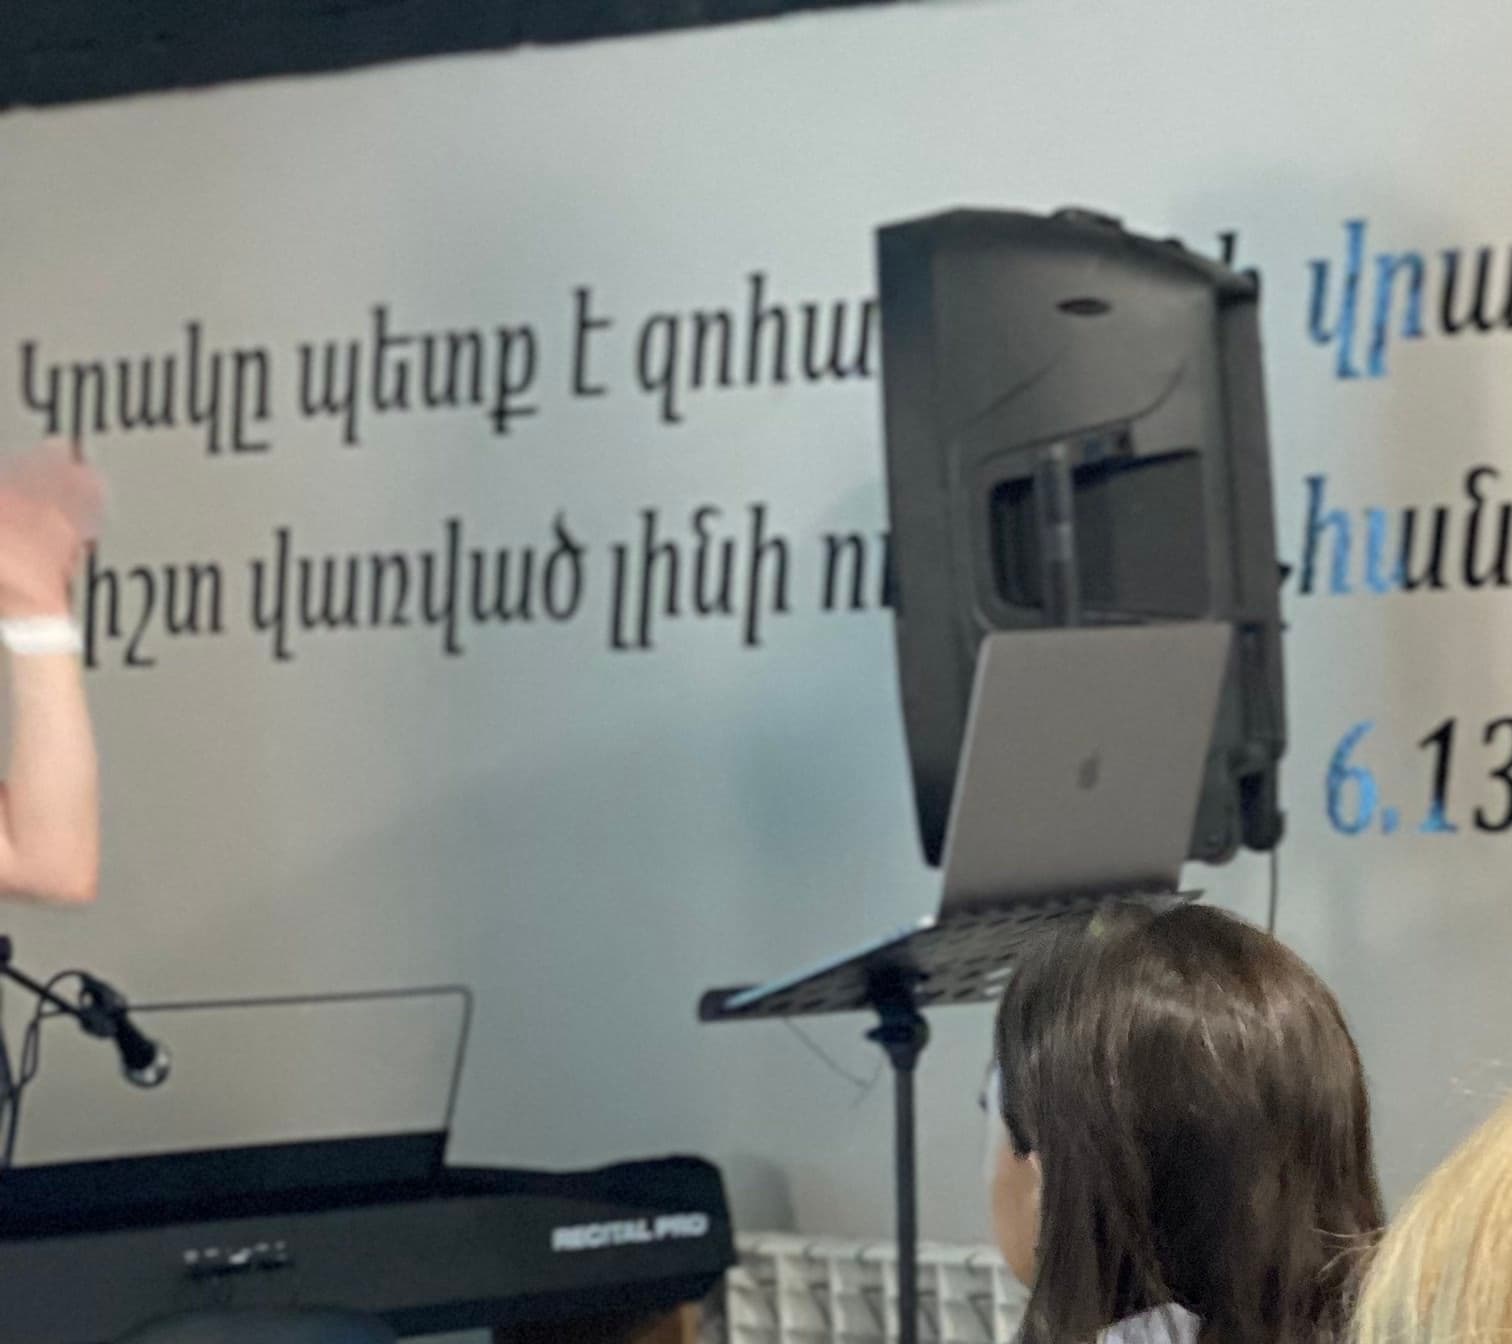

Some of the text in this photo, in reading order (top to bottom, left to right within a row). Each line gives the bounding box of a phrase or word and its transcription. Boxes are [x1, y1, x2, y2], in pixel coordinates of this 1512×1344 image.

[20, 320, 270, 461] Կրակը
[298, 304, 538, 446] պետք
[572, 287, 612, 396] է
[637, 272, 878, 424] զոհա
[82, 538, 224, 669] իշտ
[250, 508, 586, 662] վառված
[608, 502, 788, 650] լինի
[552, 1211, 709, 1251] RECITAL PRO
